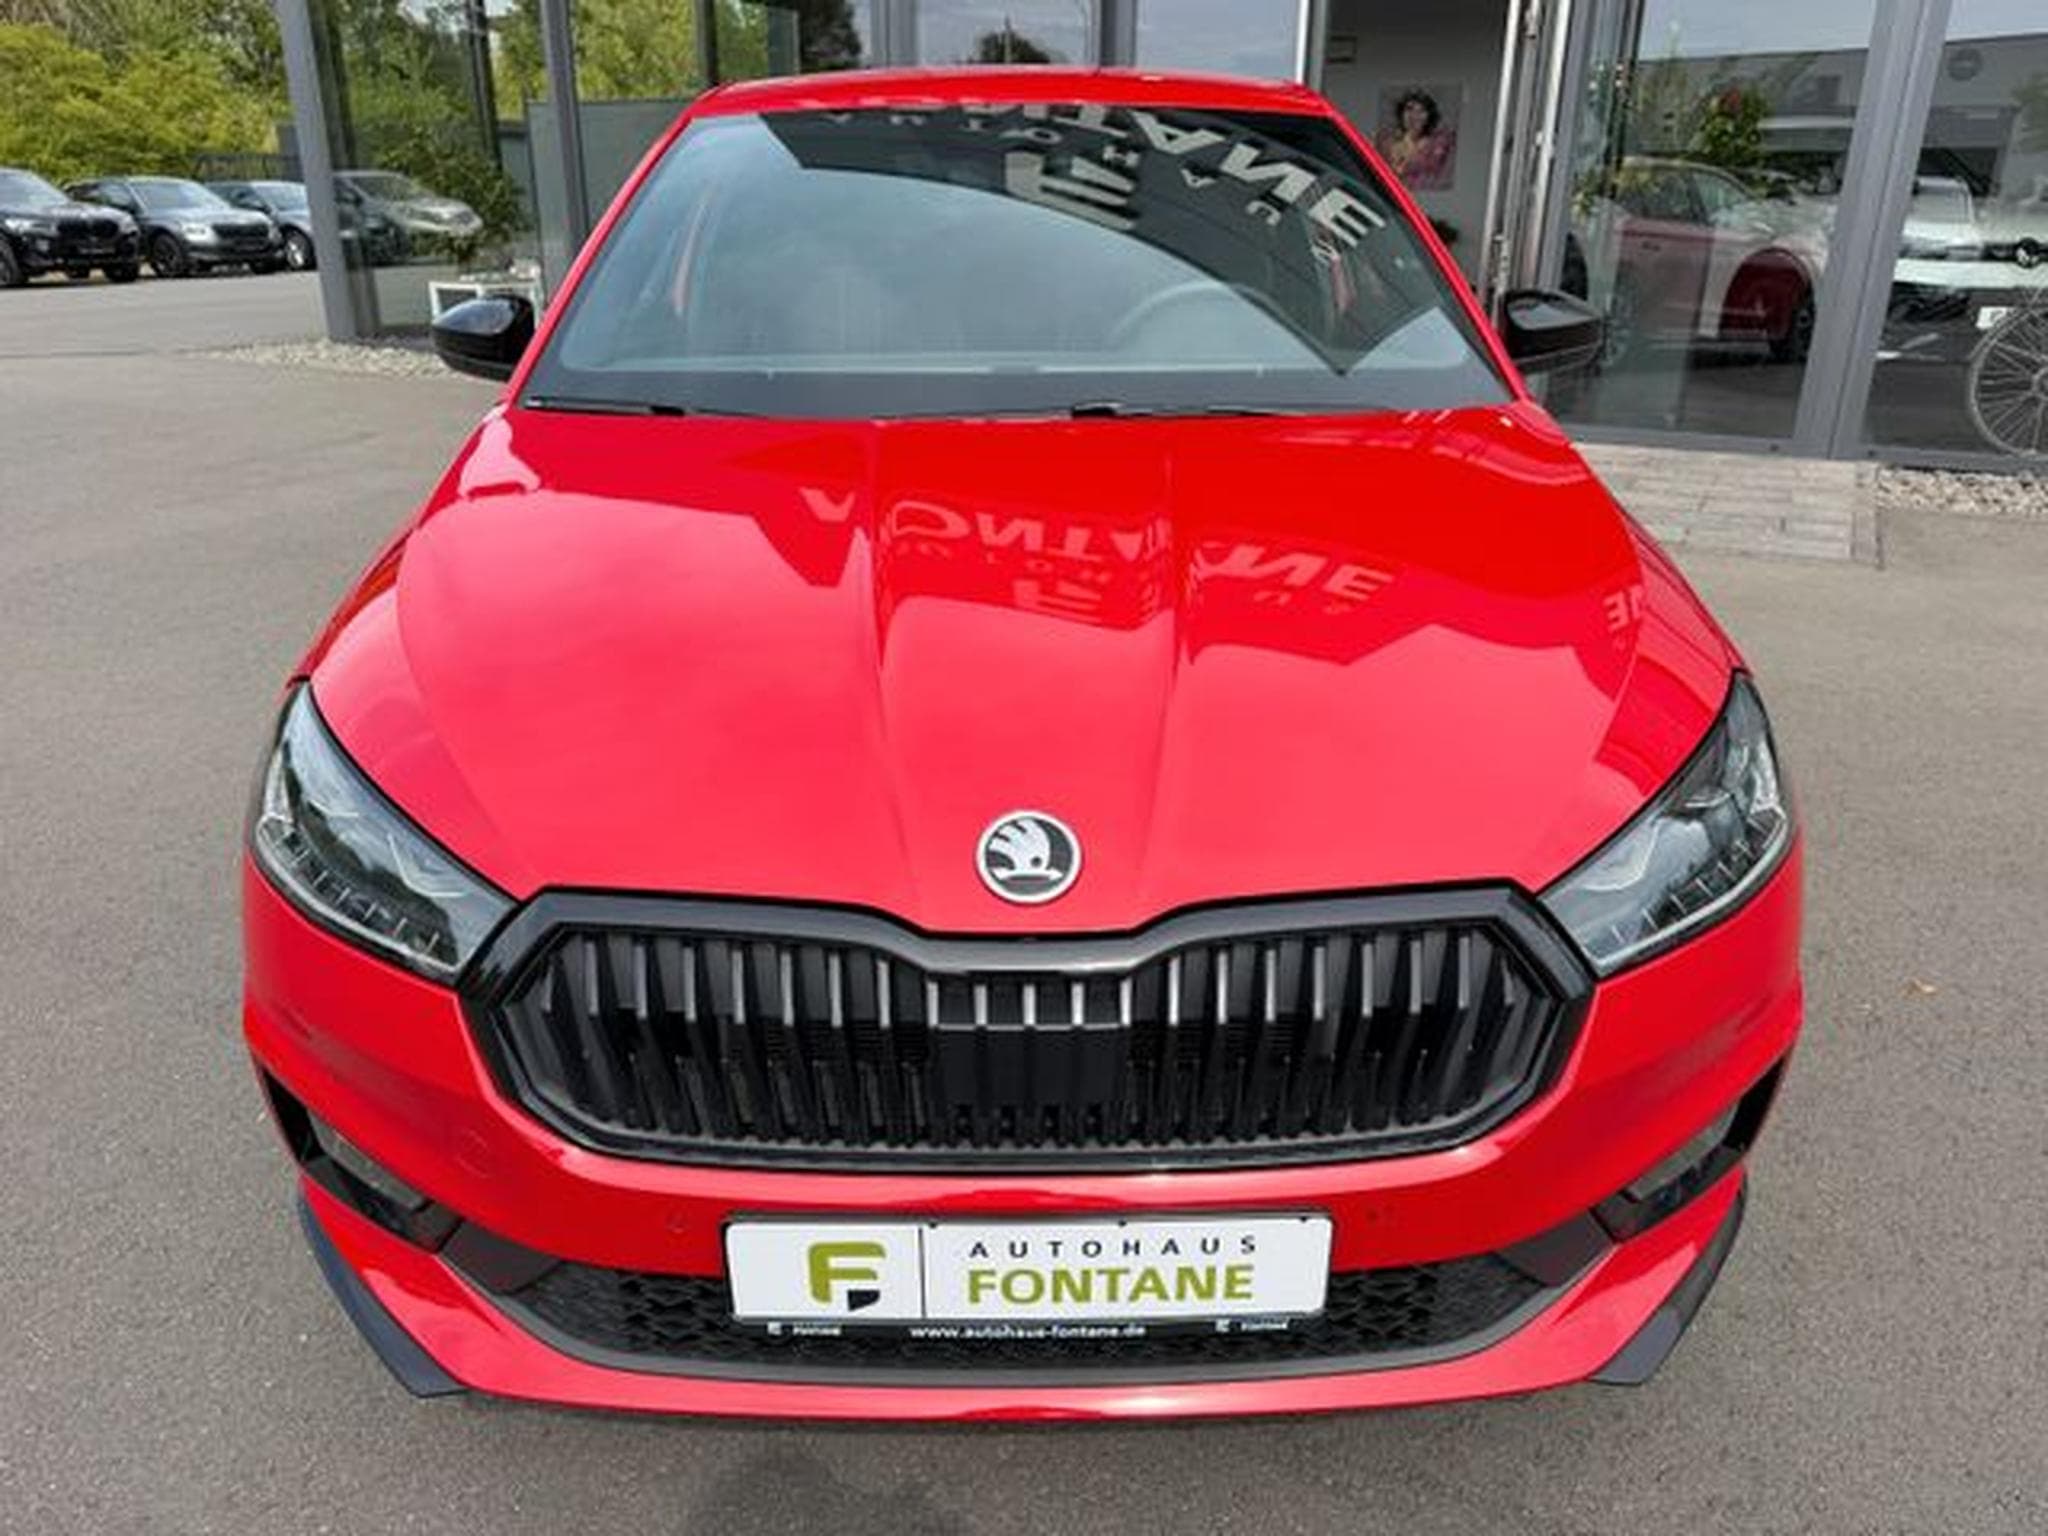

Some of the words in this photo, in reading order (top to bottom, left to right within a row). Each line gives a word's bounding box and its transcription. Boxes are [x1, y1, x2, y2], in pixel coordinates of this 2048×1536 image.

[968, 1235, 1256, 1258] AUTOHAUS
[968, 1265, 1255, 1303] FONTANE
[909, 1324, 1146, 1339] www.autohaus-fontane.de
